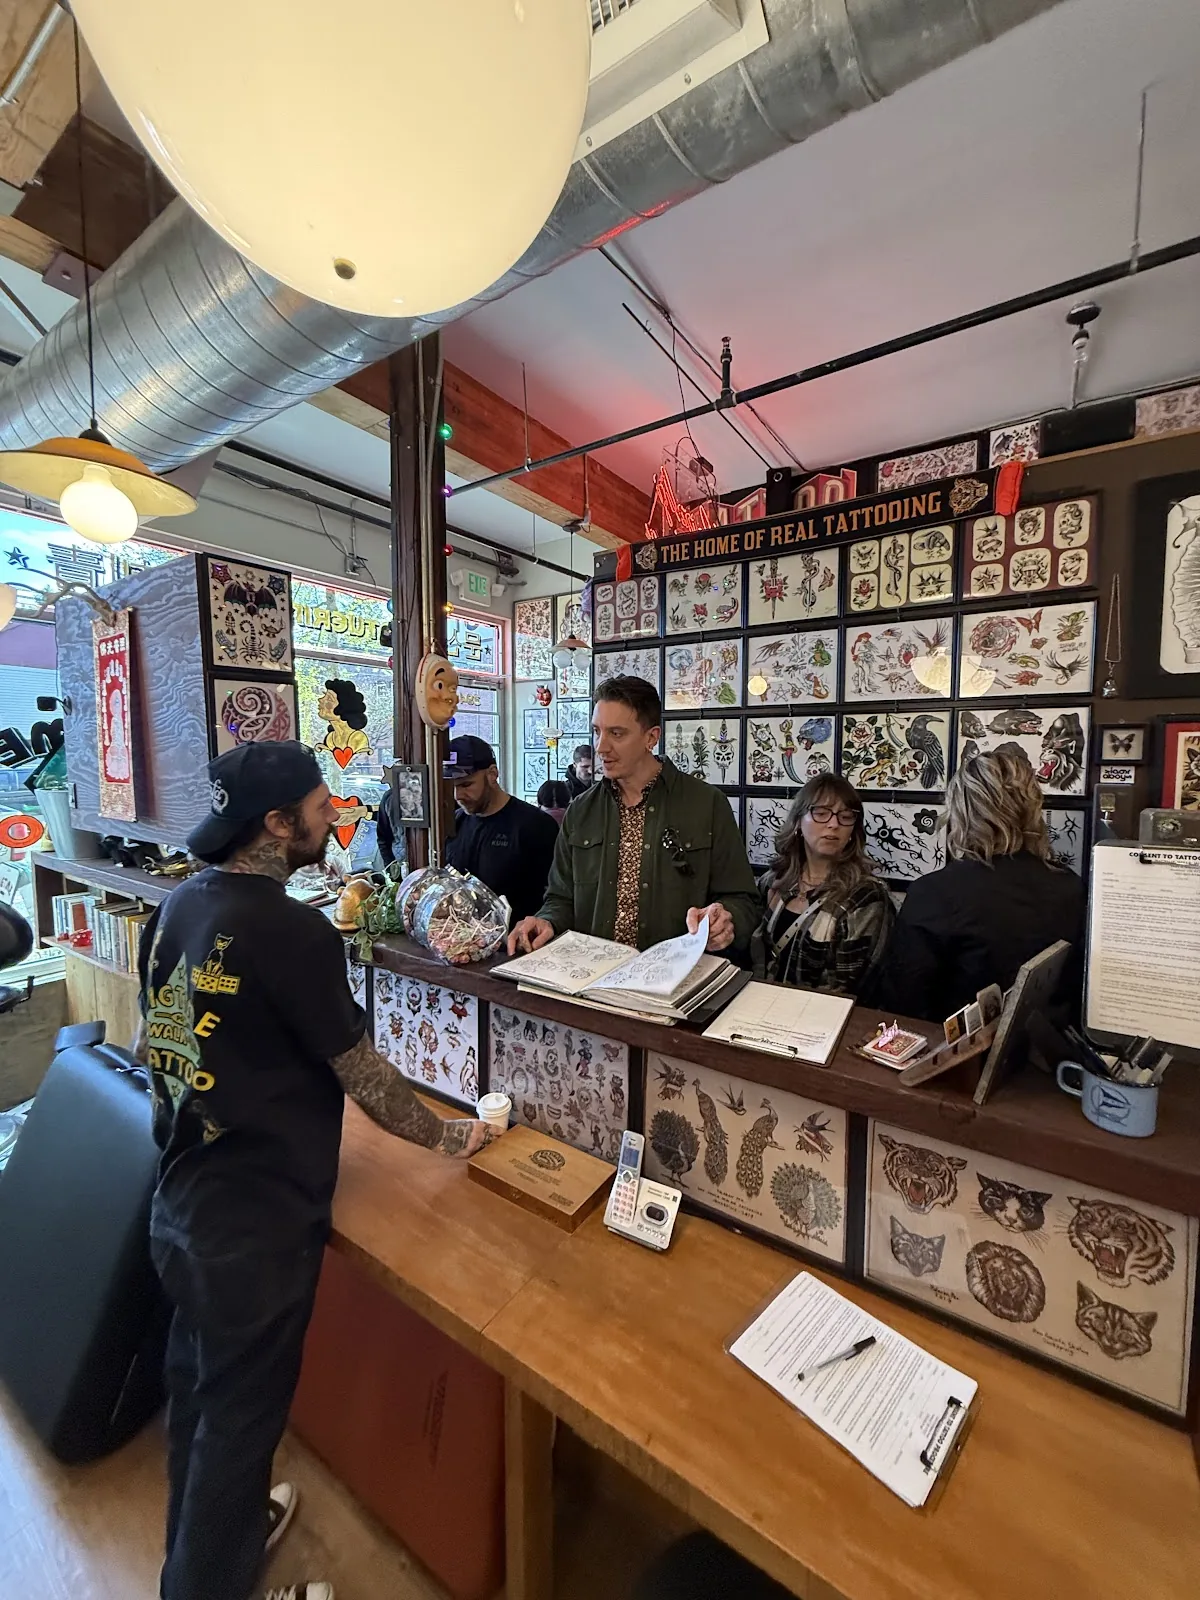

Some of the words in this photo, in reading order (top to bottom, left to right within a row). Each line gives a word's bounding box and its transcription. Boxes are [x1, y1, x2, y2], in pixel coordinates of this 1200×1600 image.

[660, 541, 689, 564] THE
[693, 532, 740, 559] HOME
[743, 528, 766, 551] OF
[770, 522, 819, 547] REAL
[823, 490, 942, 536] TATTOOING
[468, 572, 487, 596] EXIT
